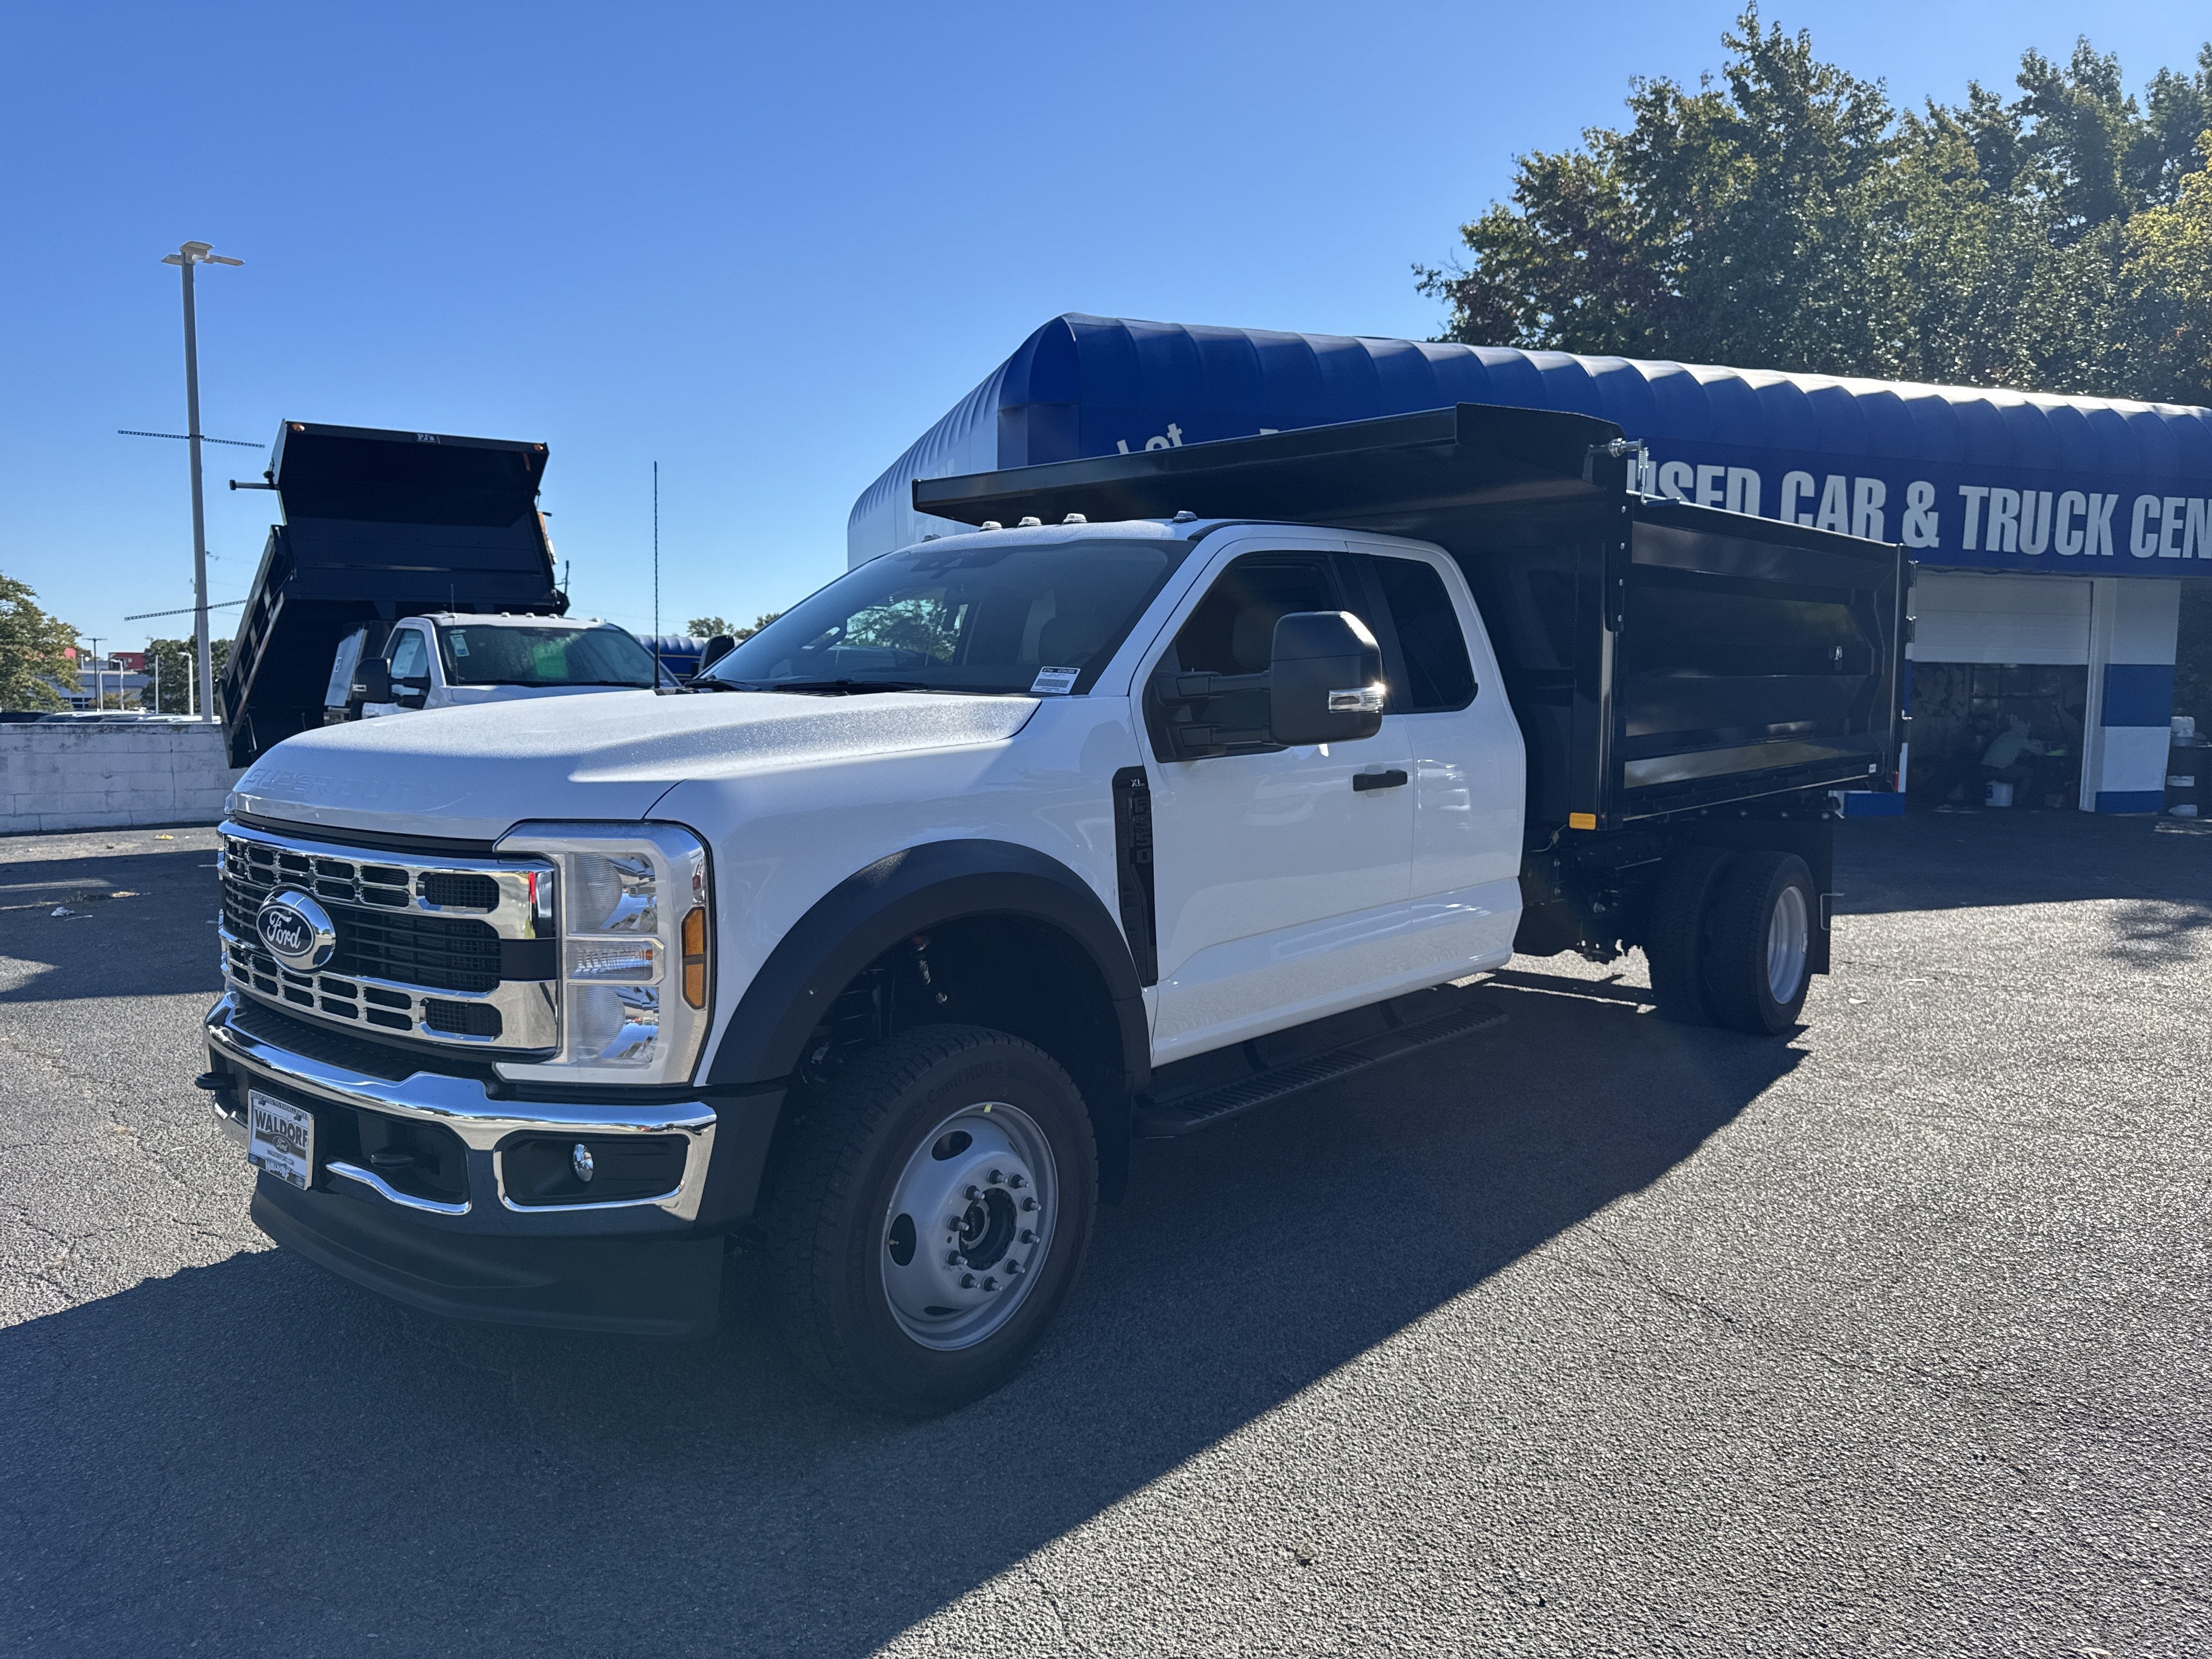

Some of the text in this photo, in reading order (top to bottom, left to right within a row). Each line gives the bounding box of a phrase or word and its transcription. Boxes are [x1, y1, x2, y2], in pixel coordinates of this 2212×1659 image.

[1780, 471, 1886, 543] CAR
[1901, 481, 1939, 548] &
[1959, 485, 2119, 556] TRUCK
[1130, 778, 1146, 787] XL
[267, 911, 302, 949] Ford
[255, 1108, 308, 1148] WALDORF
[276, 1138, 289, 1152] Ford
